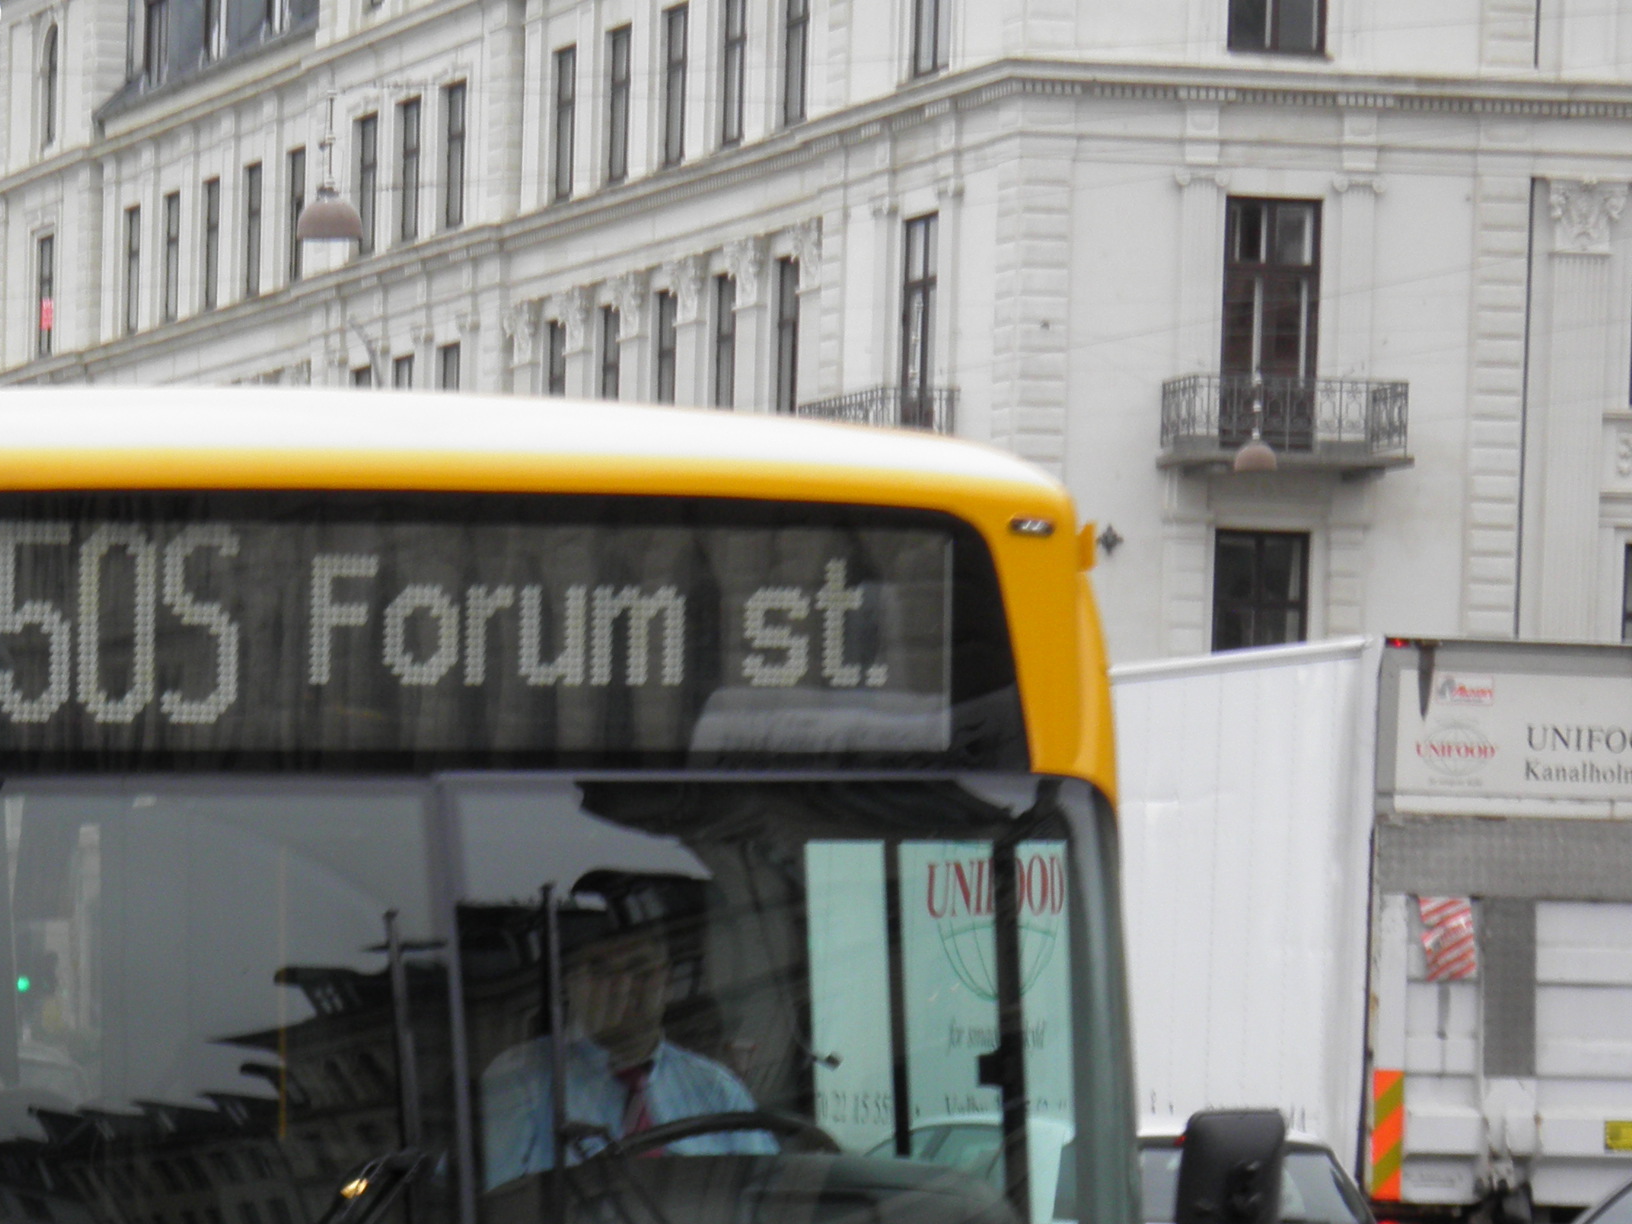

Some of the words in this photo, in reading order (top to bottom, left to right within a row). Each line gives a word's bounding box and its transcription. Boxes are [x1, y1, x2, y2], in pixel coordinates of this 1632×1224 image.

[308, 554, 686, 687] Forum
[742, 558, 889, 687] st.
[1526, 723, 1632, 755] UNIFO
